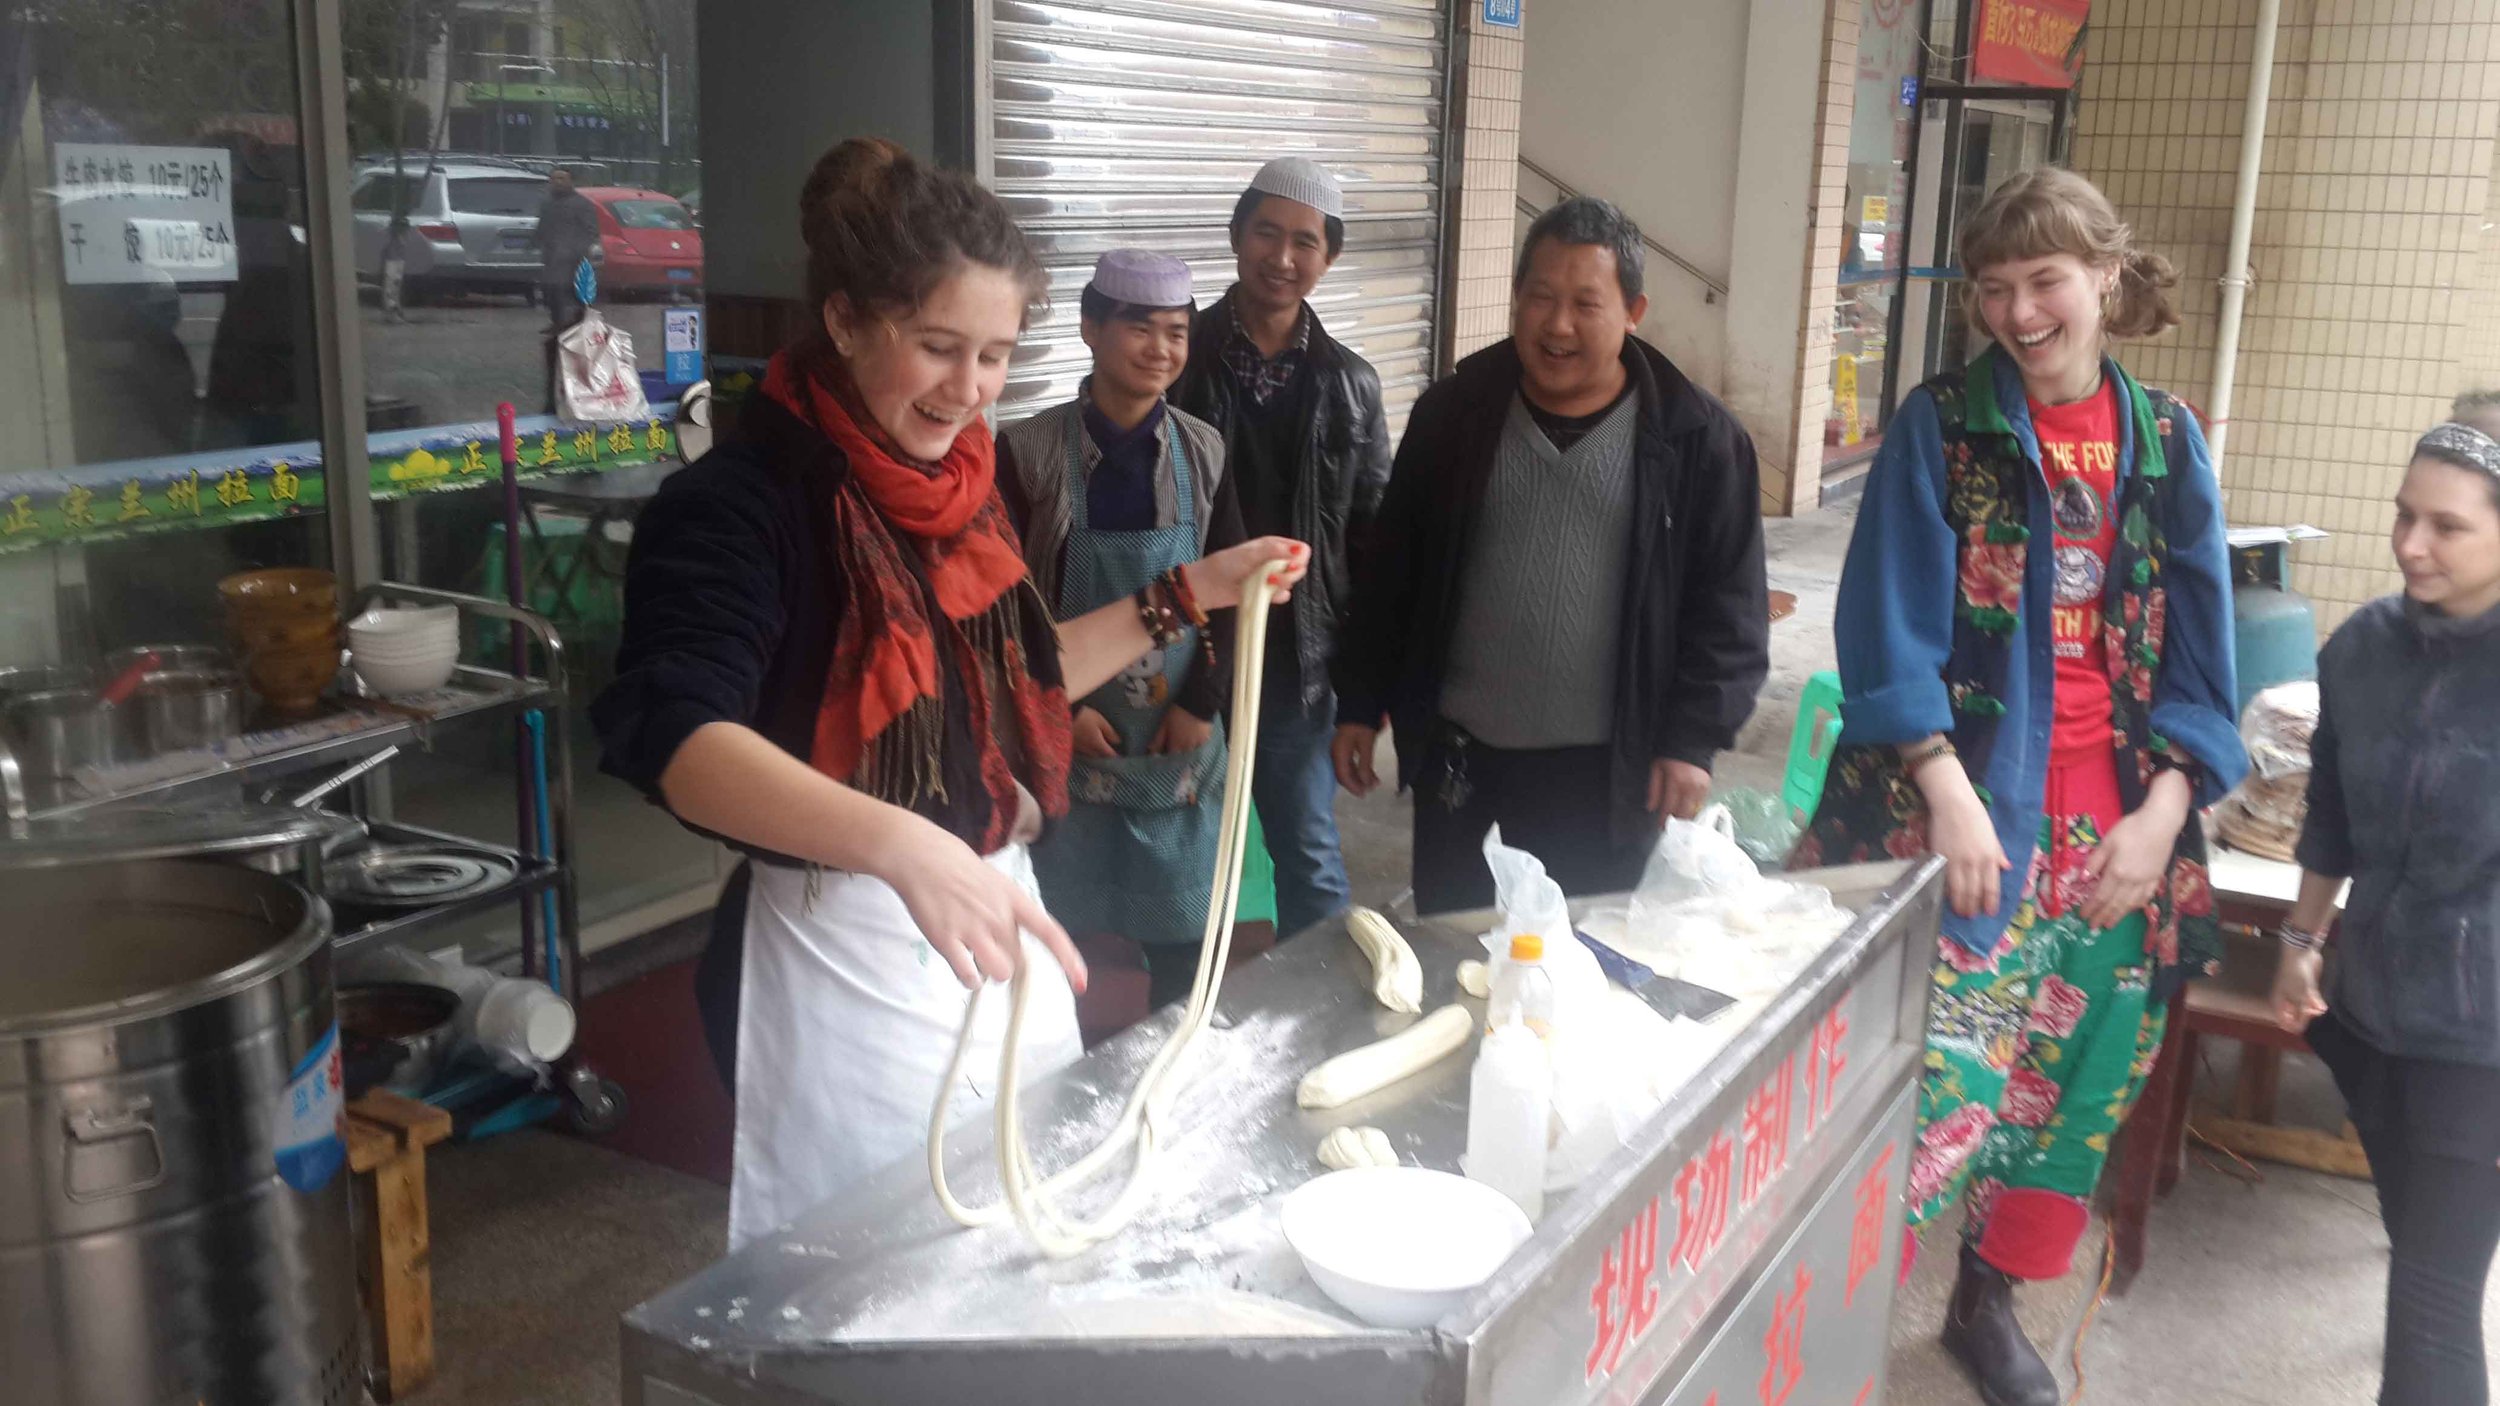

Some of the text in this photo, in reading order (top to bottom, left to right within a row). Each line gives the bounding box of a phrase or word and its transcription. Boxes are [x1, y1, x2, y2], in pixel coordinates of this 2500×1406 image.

[1, 461, 300, 536] 正宗兰州拉面
